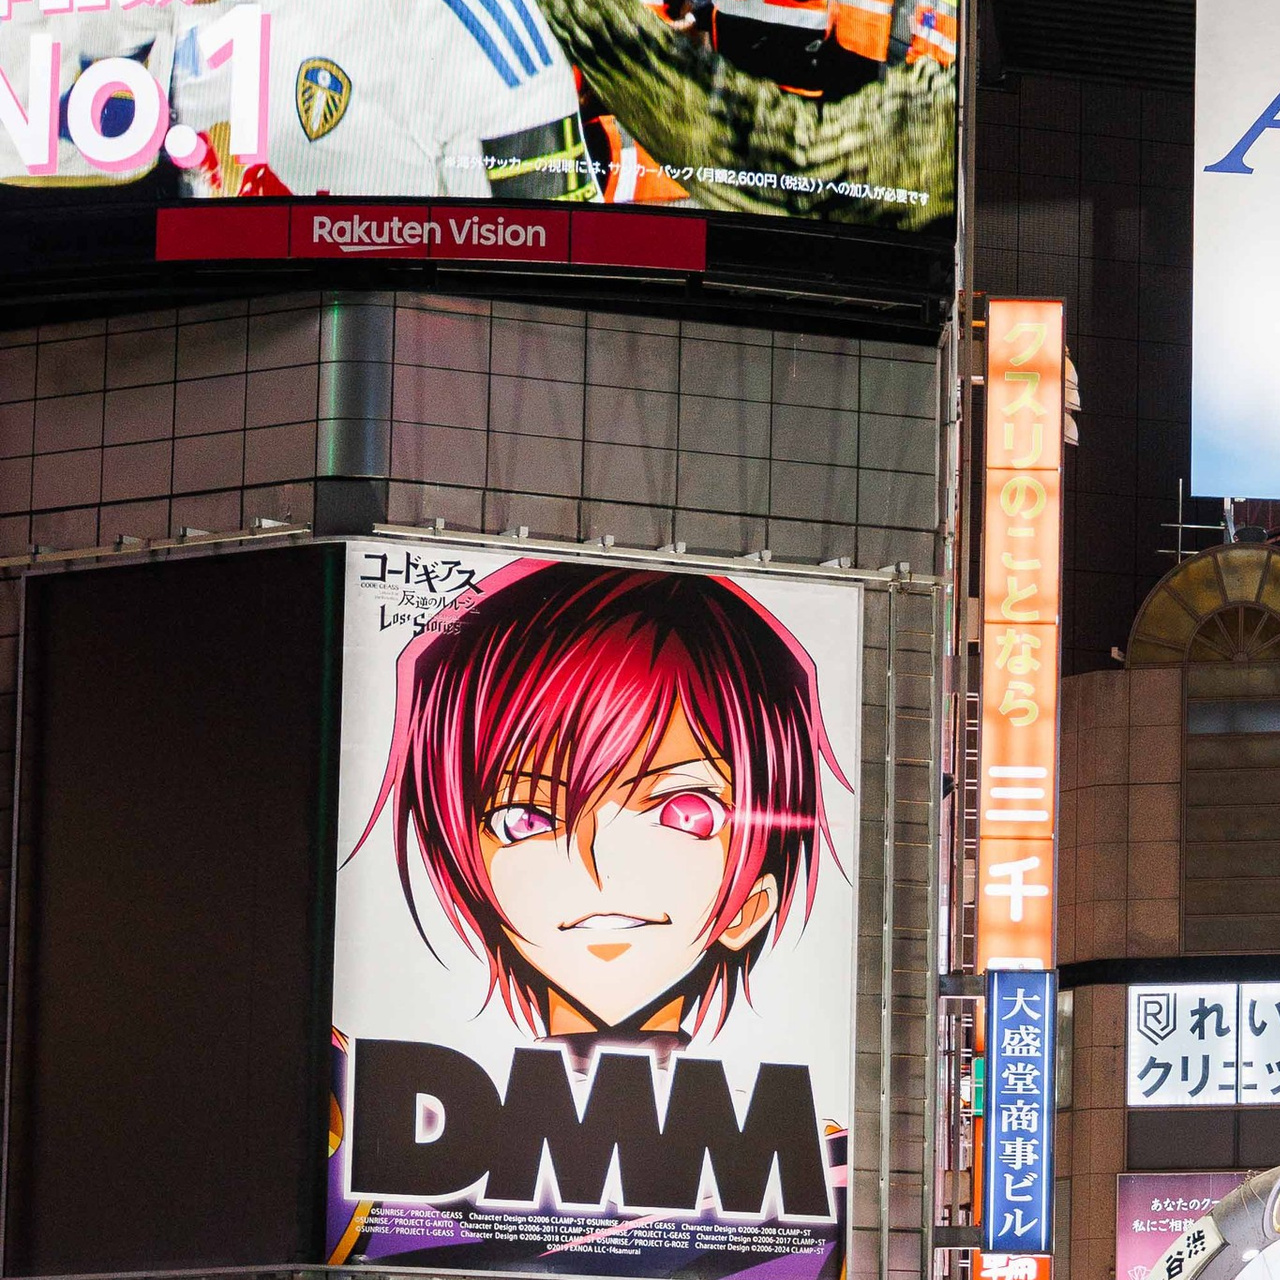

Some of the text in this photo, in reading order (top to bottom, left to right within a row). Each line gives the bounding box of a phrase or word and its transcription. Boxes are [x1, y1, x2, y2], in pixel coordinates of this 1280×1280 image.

[313, 215, 546, 247] Rakuten Vision
[995, 322, 1048, 728] クスリのことなら
[360, 551, 485, 594] コードギアス
[350, 1037, 832, 1218] DMM
[998, 987, 1042, 1238] 大盛堂商事ビル
[460, 1221, 492, 1231] Character
[494, 1223, 518, 1233] Design
[696, 1233, 728, 1242] Character
[729, 1234, 751, 1244] Design
[461, 1230, 493, 1239] Character
[495, 1232, 518, 1241] Design
[695, 1242, 727, 1251] Character
[728, 1243, 750, 1252] Design
[469, 1212, 502, 1222] Character
[503, 1215, 527, 1223] Design
[681, 1223, 713, 1233] Character
